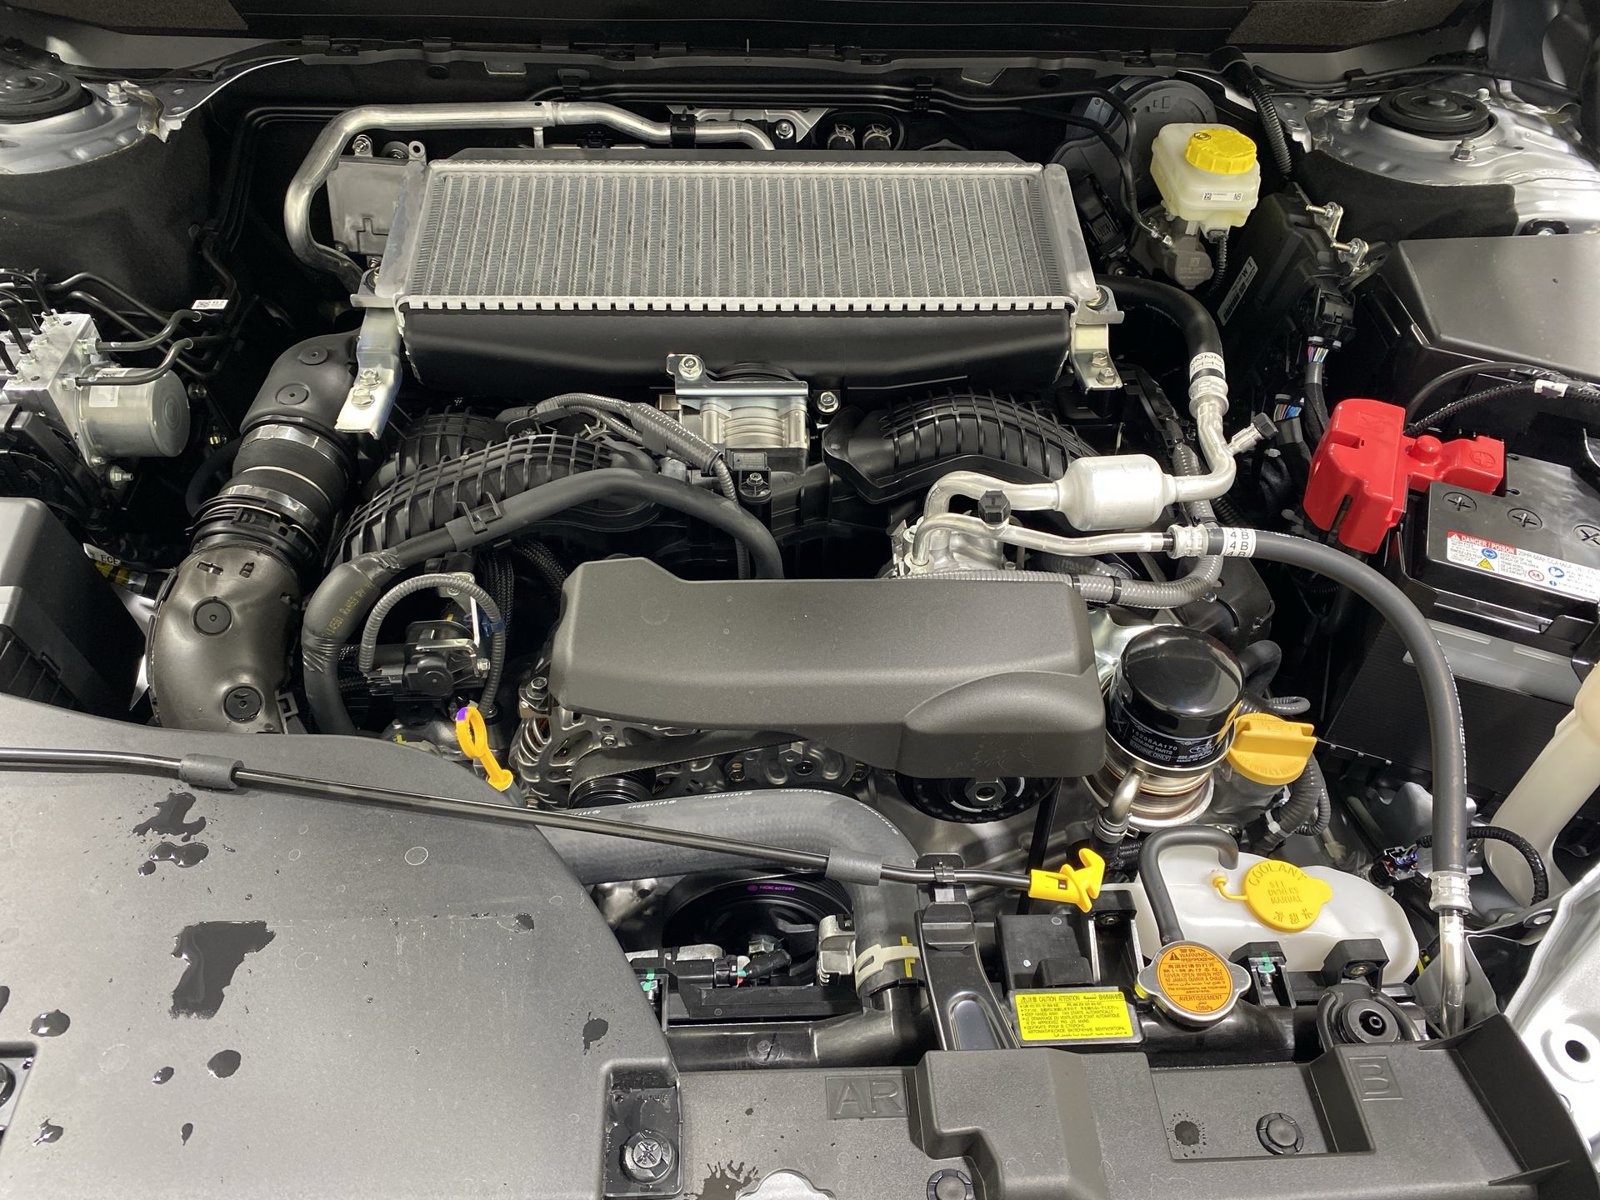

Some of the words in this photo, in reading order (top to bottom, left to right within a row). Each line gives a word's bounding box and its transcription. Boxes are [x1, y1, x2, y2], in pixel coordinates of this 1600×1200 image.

[1461, 535, 1488, 548] DANGER
[1491, 543, 1515, 555] POISON
[1248, 863, 1308, 887] COOLANT
[835, 1080, 905, 1115] AR
